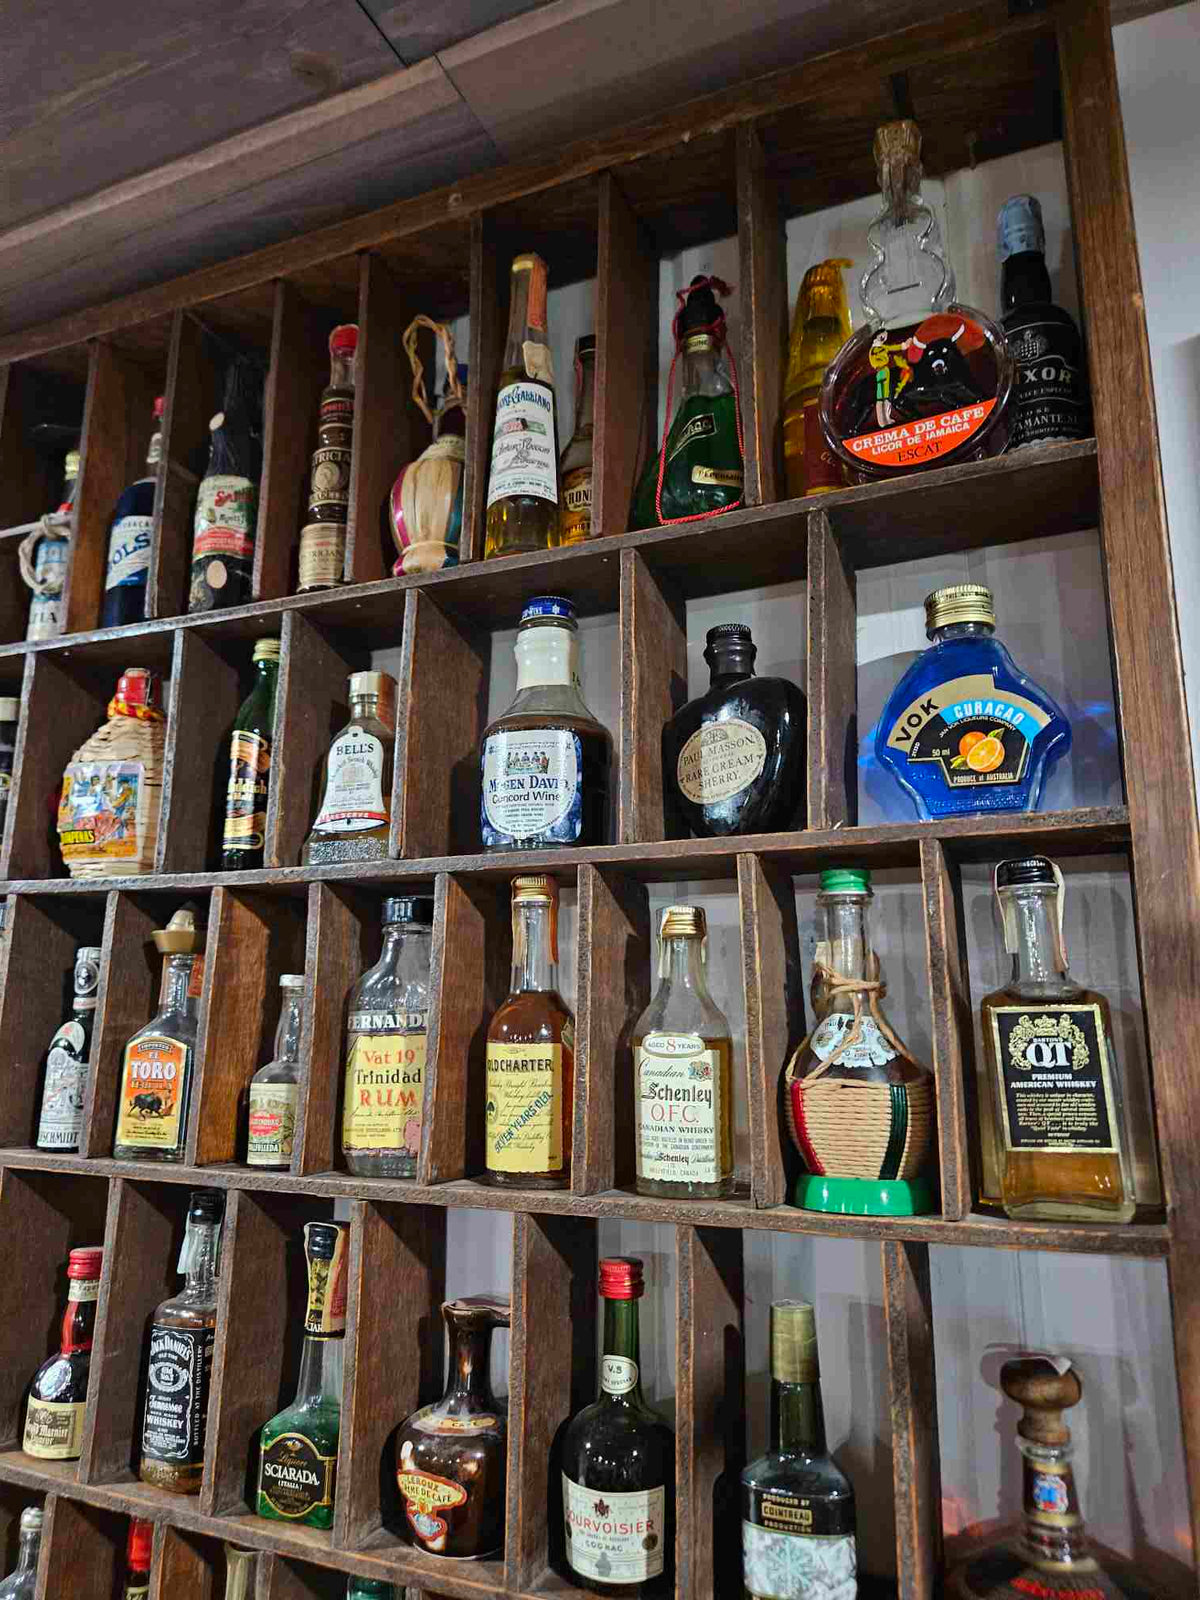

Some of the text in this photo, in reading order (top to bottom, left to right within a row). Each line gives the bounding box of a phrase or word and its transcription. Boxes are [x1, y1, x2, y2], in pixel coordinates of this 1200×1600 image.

[852, 427, 910, 451] CREMA
[914, 420, 936, 434] DE
[871, 422, 971, 456] LICOR DE JAMAICA
[895, 697, 939, 744] VOK
[990, 716, 1016, 731] COMPANY
[336, 743, 375, 756] BELL'S
[683, 735, 755, 767] PAUL MASSON
[931, 748, 950, 757] 50 ml
[712, 754, 755, 773] CREAM
[699, 770, 739, 790] SHERRY
[953, 774, 976, 783] PRODUCE
[986, 772, 1014, 781] AUSTRALIA
[532, 791, 560, 801] Wine
[665, 1038, 676, 1052] 8
[1026, 1041, 1072, 1068] QT
[131, 1061, 177, 1080] TORO
[500, 1058, 555, 1073] CHARTER
[638, 1056, 685, 1078] Canadian
[355, 1068, 421, 1085] Trinidad
[1010, 1080, 1097, 1089] AMERICAN WHISKEY
[1031, 1073, 1072, 1081] PREMIUM
[359, 1088, 419, 1108] RUM
[641, 1081, 713, 1110] Schenley
[510, 1105, 538, 1131] YEARS
[650, 1102, 700, 1124] O.F.C.
[654, 1152, 690, 1166] Schenley
[165, 1335, 192, 1361] DANIEL'S
[147, 1414, 185, 1429] WHISKEY
[763, 1505, 811, 1522] COINTREAU
[585, 1540, 624, 1552] COGNAC
